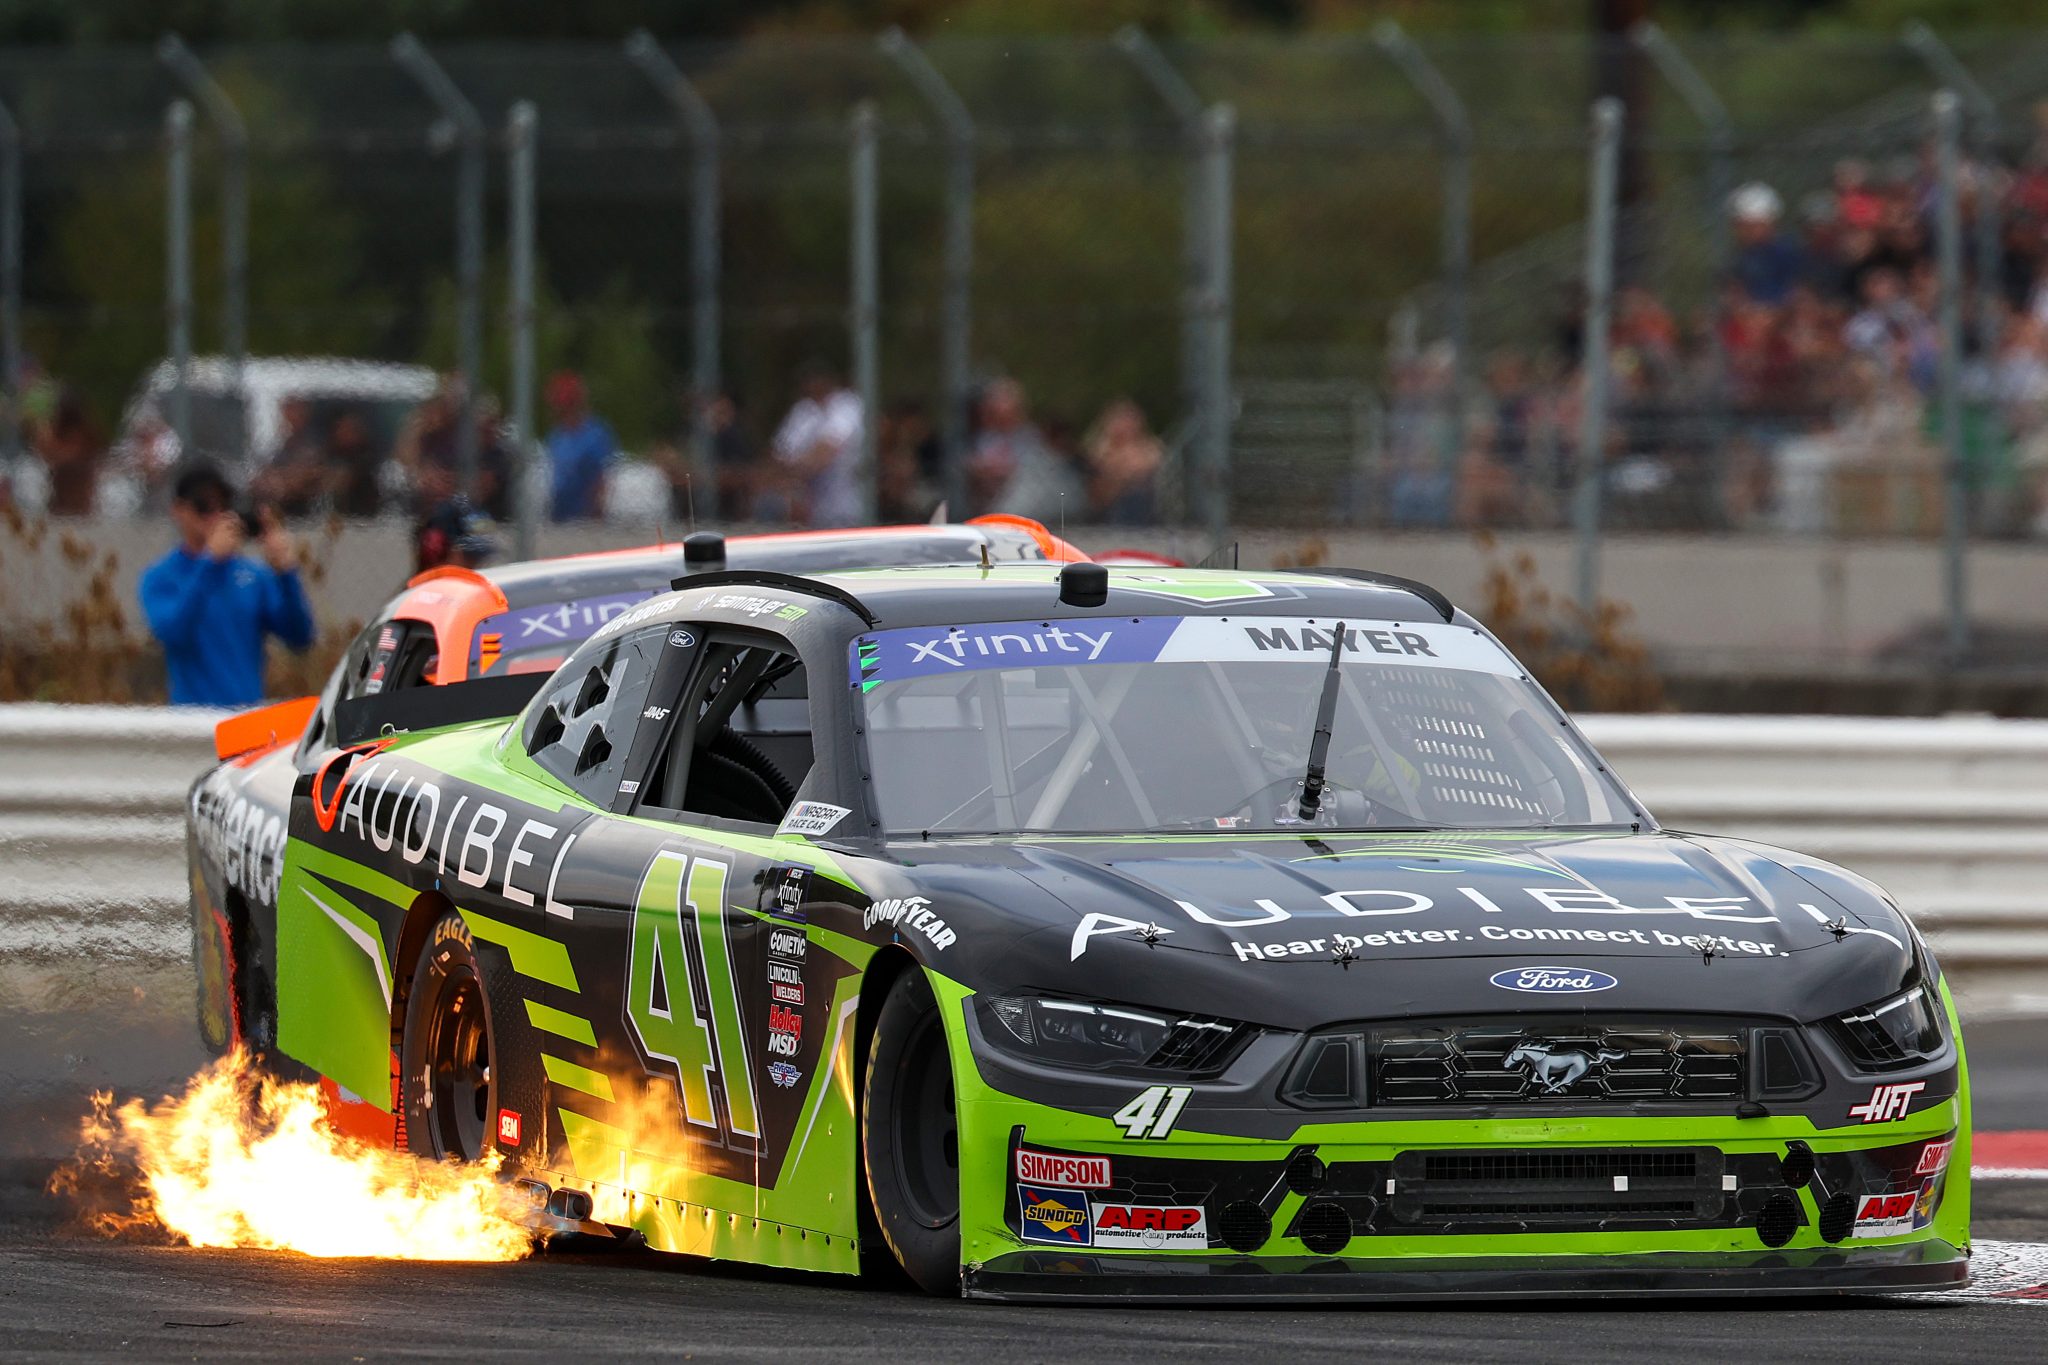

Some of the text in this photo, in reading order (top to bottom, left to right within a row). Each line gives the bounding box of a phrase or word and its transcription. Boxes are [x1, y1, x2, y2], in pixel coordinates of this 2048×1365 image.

[520, 601, 642, 637] xfin
[905, 627, 1112, 667] xfinity
[1244, 626, 1439, 658] MAYER
[787, 818, 826, 831] RACE CAR
[804, 805, 838, 821] NASCAR
[340, 762, 575, 920] AUDIBEL
[777, 879, 803, 910] xfinity
[434, 917, 473, 953] EAGLE
[863, 896, 957, 951] GOODYEAR
[1071, 888, 1904, 962] AUDIBEL
[770, 932, 806, 956] COMETIC
[1231, 925, 1790, 962] Hear better. Connect better.
[769, 965, 798, 984] LINCOLN
[1516, 969, 1594, 989] Ford
[627, 850, 760, 1139] 41
[775, 985, 801, 1001] WELDERS
[769, 1004, 802, 1041] Holley
[768, 1032, 797, 1056] MSD
[1112, 1085, 1194, 1139] 41
[1021, 1154, 1105, 1185] SIMPSON
[1028, 1206, 1084, 1224] SUNOCO
[1096, 1206, 1201, 1231] ARP
[1856, 1192, 1916, 1220] ARP
[1095, 1229, 1141, 1238] automotive
[1166, 1231, 1206, 1240] products
